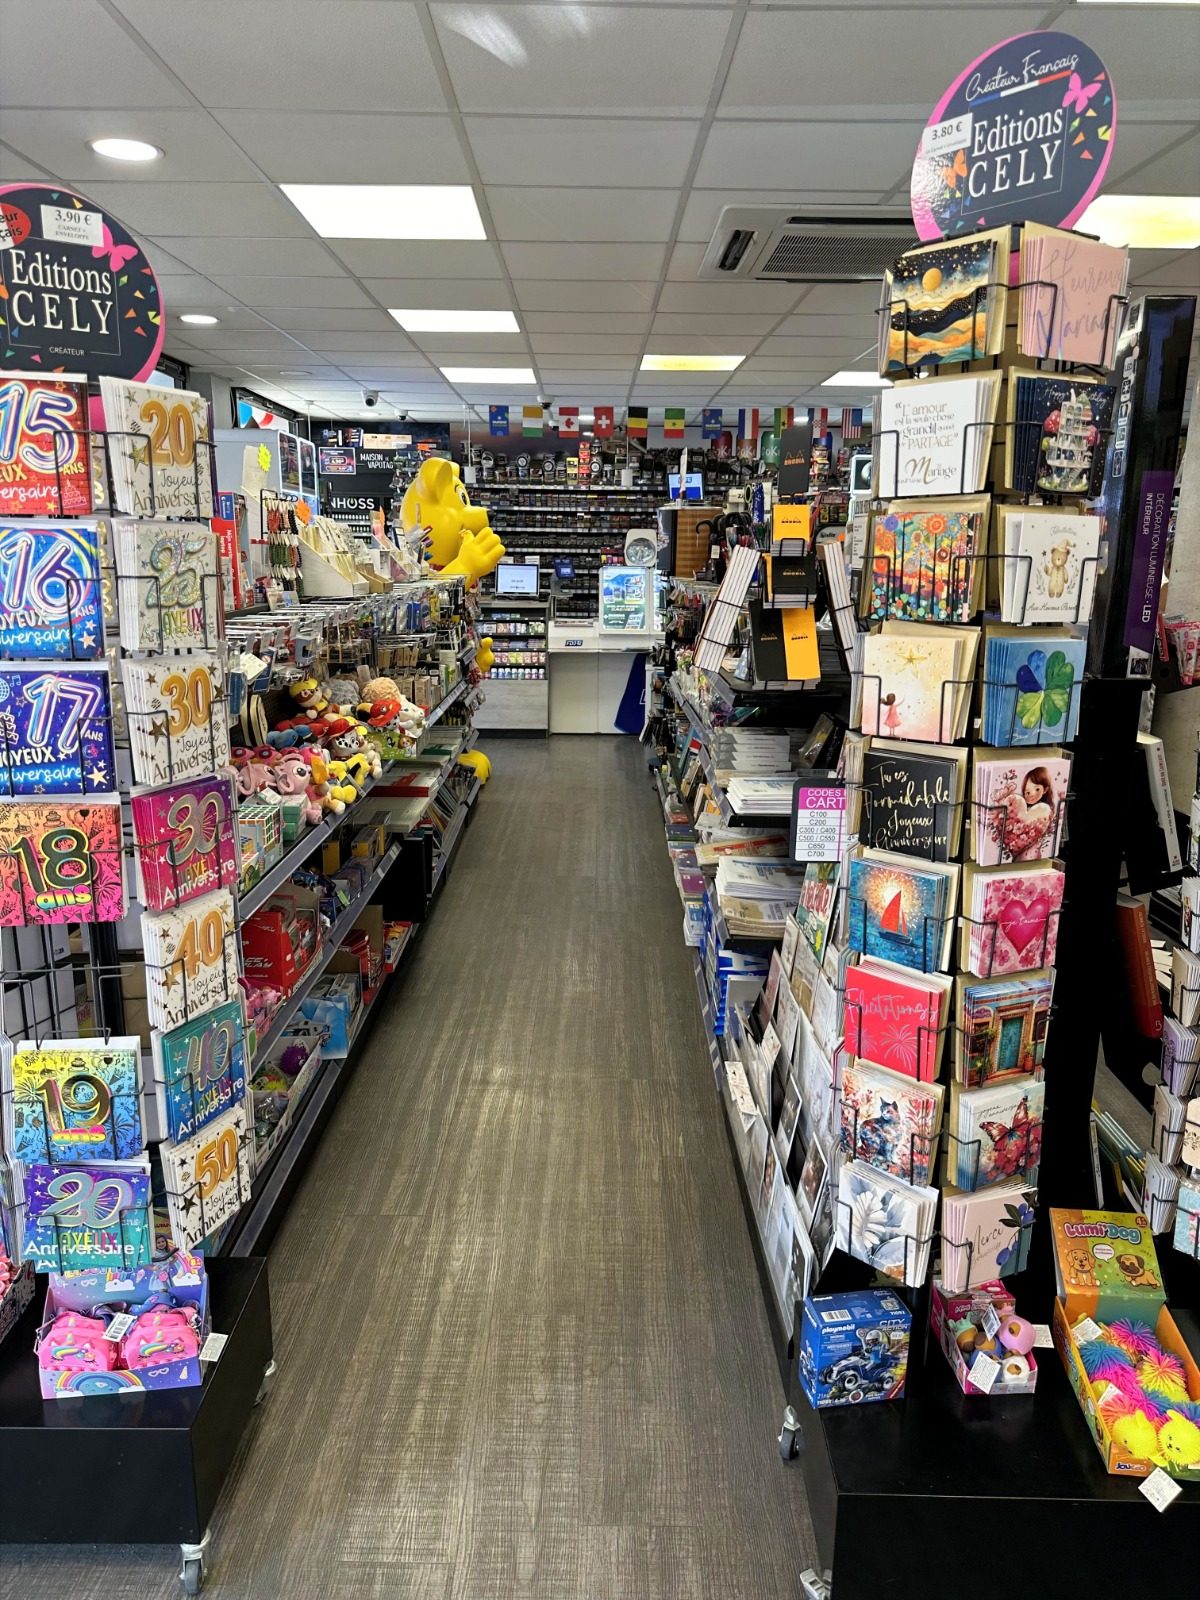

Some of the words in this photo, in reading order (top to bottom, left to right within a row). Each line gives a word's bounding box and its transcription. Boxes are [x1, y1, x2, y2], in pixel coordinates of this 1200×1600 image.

[931, 123, 954, 140] 3.80
[955, 121, 964, 132] €
[972, 107, 1063, 157] Editions
[967, 139, 1062, 198] CELY
[55, 209, 81, 224] 3.90
[84, 214, 93, 225] €
[11, 249, 112, 295] Editions
[12, 290, 114, 335] CELY
[139, 400, 196, 468] 20
[63, 462, 85, 475] ANS
[360, 453, 383, 461] MAISON
[367, 461, 394, 469] VAPOTAG
[0, 483, 59, 502] ersaire
[2, 531, 81, 614] 16
[0, 607, 50, 631] OYEUX
[75, 604, 96, 617] ANS
[162, 607, 203, 636] OYEUX
[1142, 604, 1152, 623] LED
[160, 667, 213, 736] 30
[23, 674, 101, 753] 17
[84, 730, 104, 742] ANS
[0, 766, 82, 783] nniversaire
[806, 796, 846, 809] CART
[807, 788, 842, 797] CODES
[808, 818, 827, 826] C200
[809, 810, 828, 818] C100
[887, 809, 933, 837] Joyeux
[10, 829, 97, 894] 18
[36, 886, 92, 909] ans
[171, 909, 224, 979] 40
[37, 1073, 112, 1131] 19
[51, 1124, 107, 1147] ans
[195, 1128, 238, 1198] 50
[38, 1172, 133, 1230] 20
[821, 1323, 856, 1335] playmobil
[880, 1318, 906, 1328] CITY
